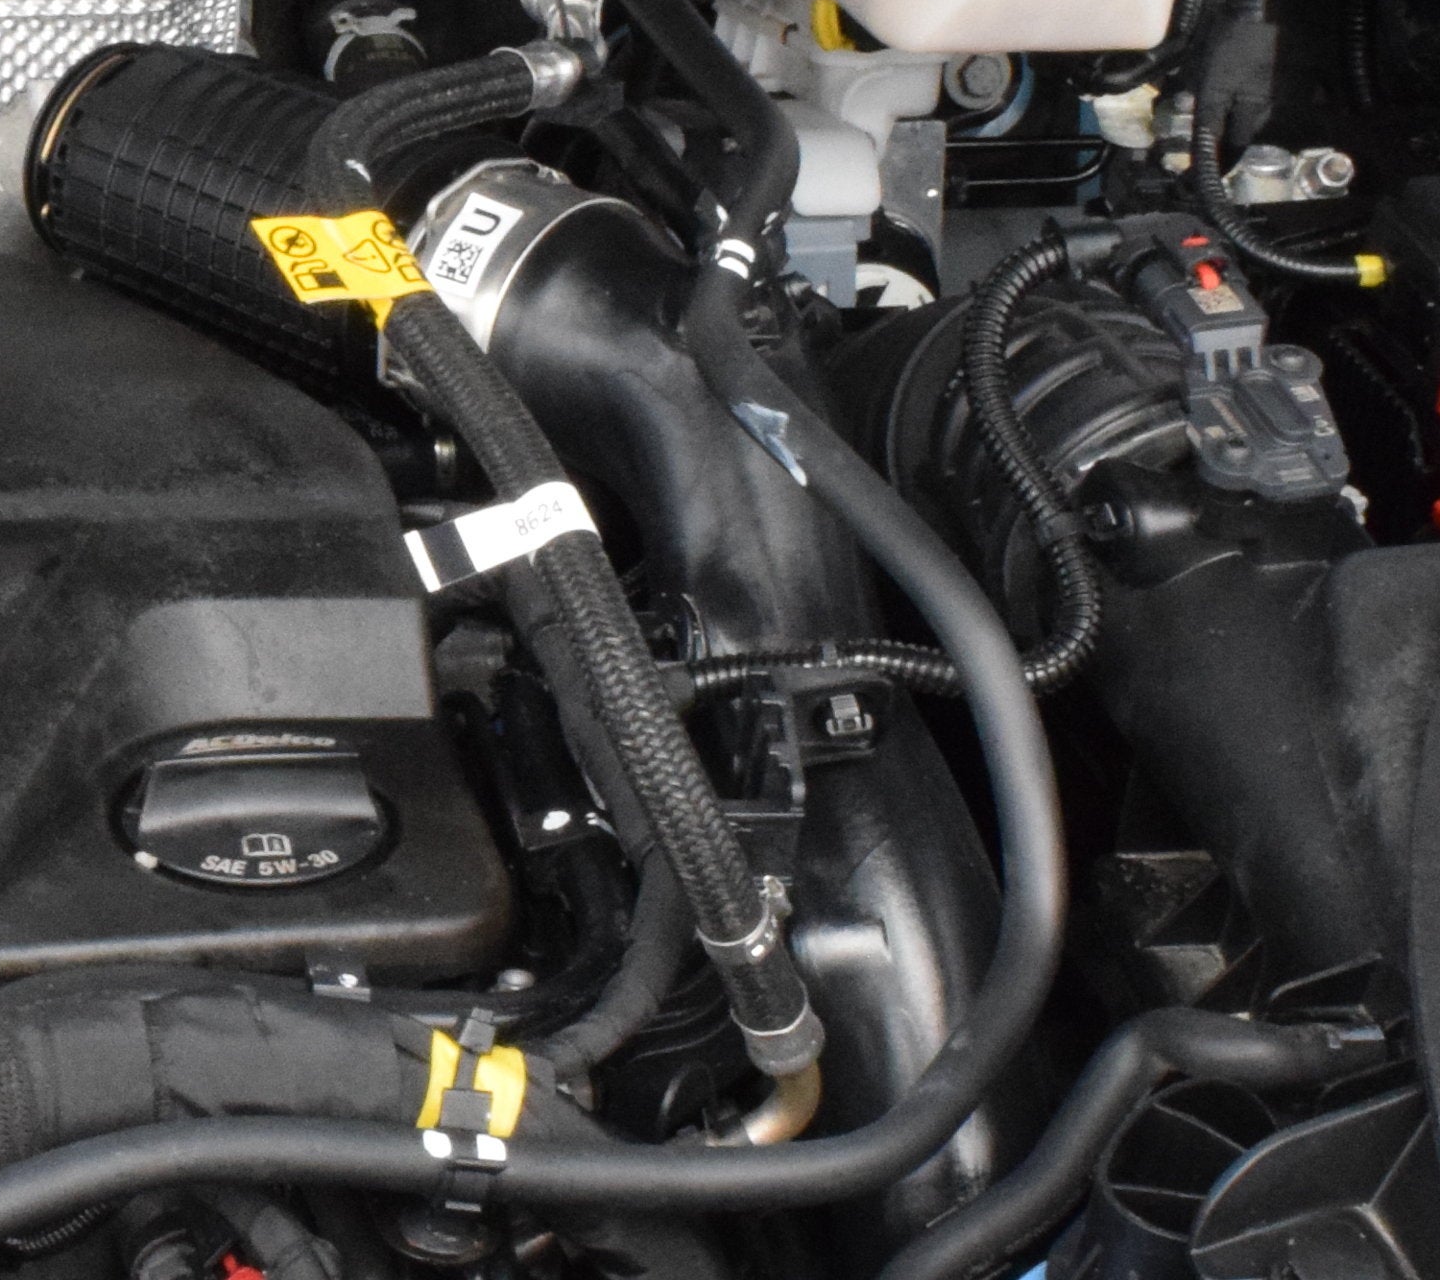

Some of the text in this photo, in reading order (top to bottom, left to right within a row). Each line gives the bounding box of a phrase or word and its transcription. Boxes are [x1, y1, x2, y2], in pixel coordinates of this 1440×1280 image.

[461, 207, 502, 237] U
[200, 848, 339, 877] SAE 5W-30
